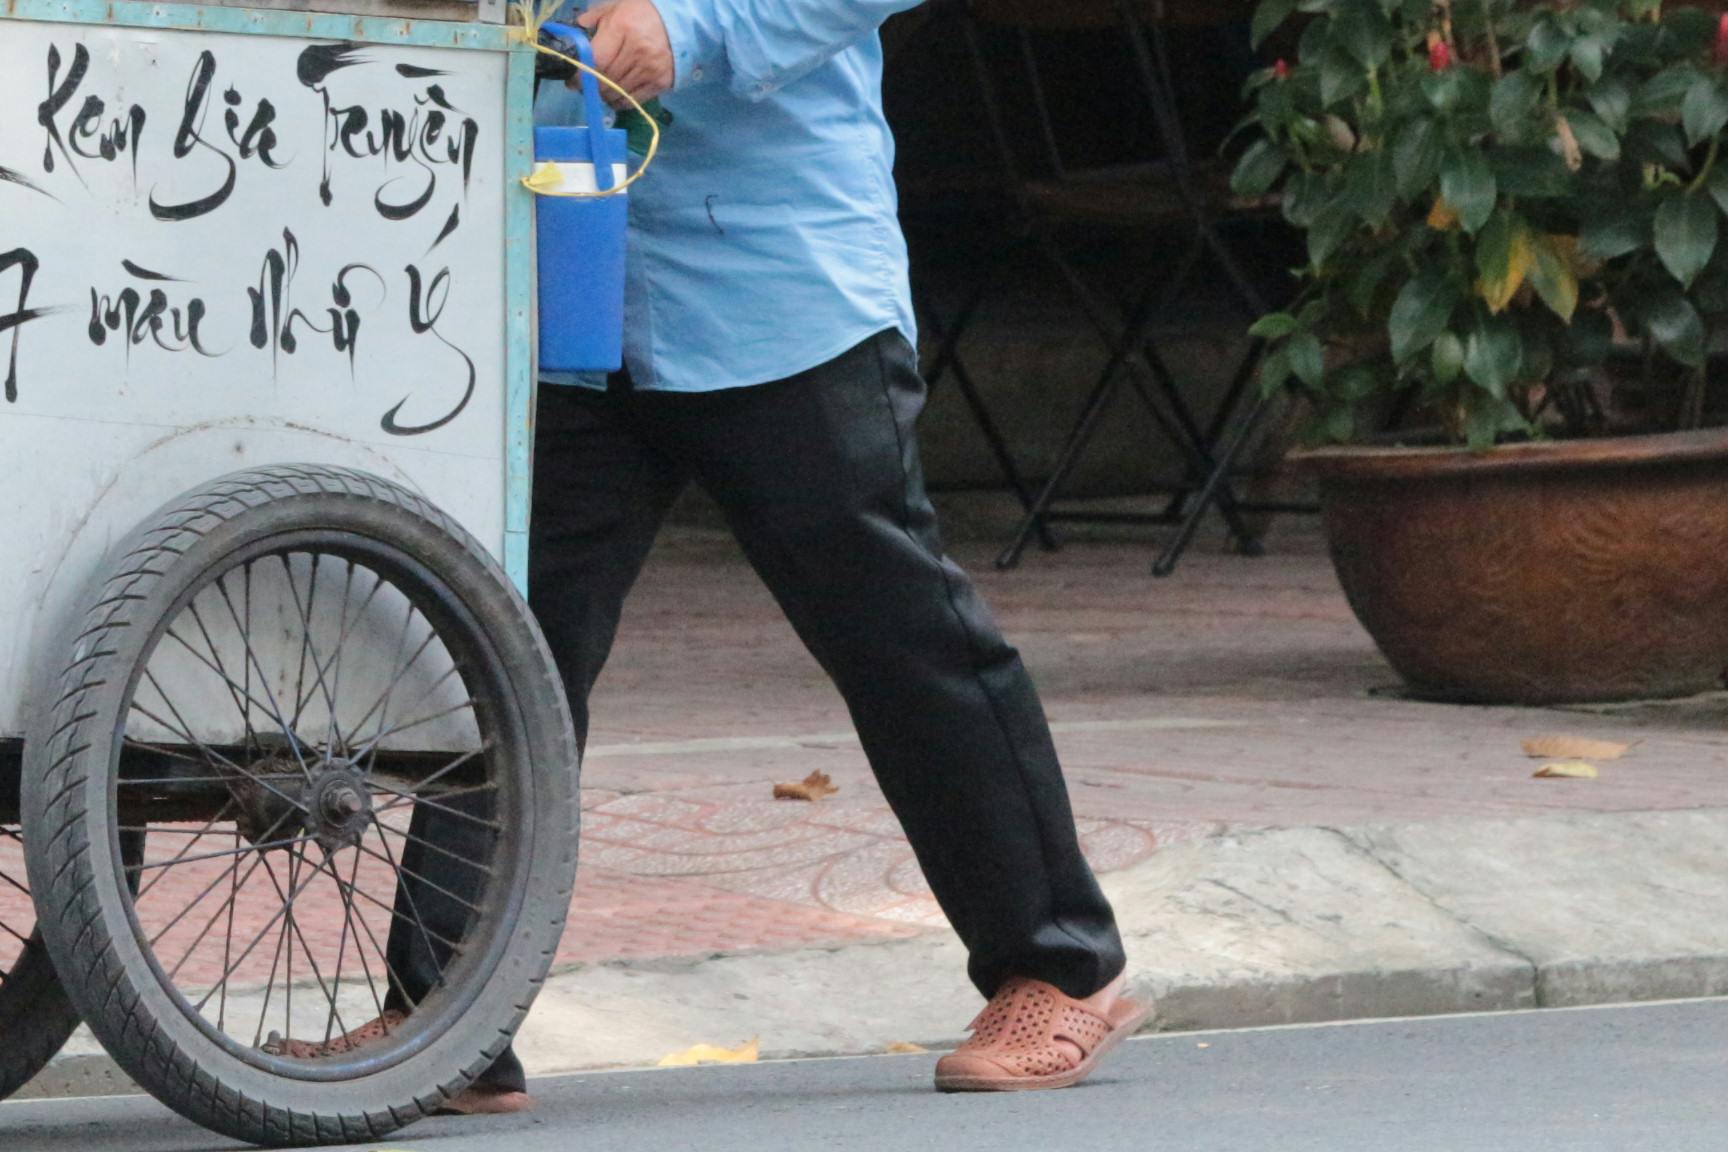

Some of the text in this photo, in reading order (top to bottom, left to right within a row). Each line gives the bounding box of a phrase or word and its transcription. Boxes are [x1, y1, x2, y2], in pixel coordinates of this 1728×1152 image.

[38, 43, 148, 193] Kem
[149, 50, 288, 221] Gia
[297, 44, 479, 221] Truyền
[247, 226, 387, 391] Như
